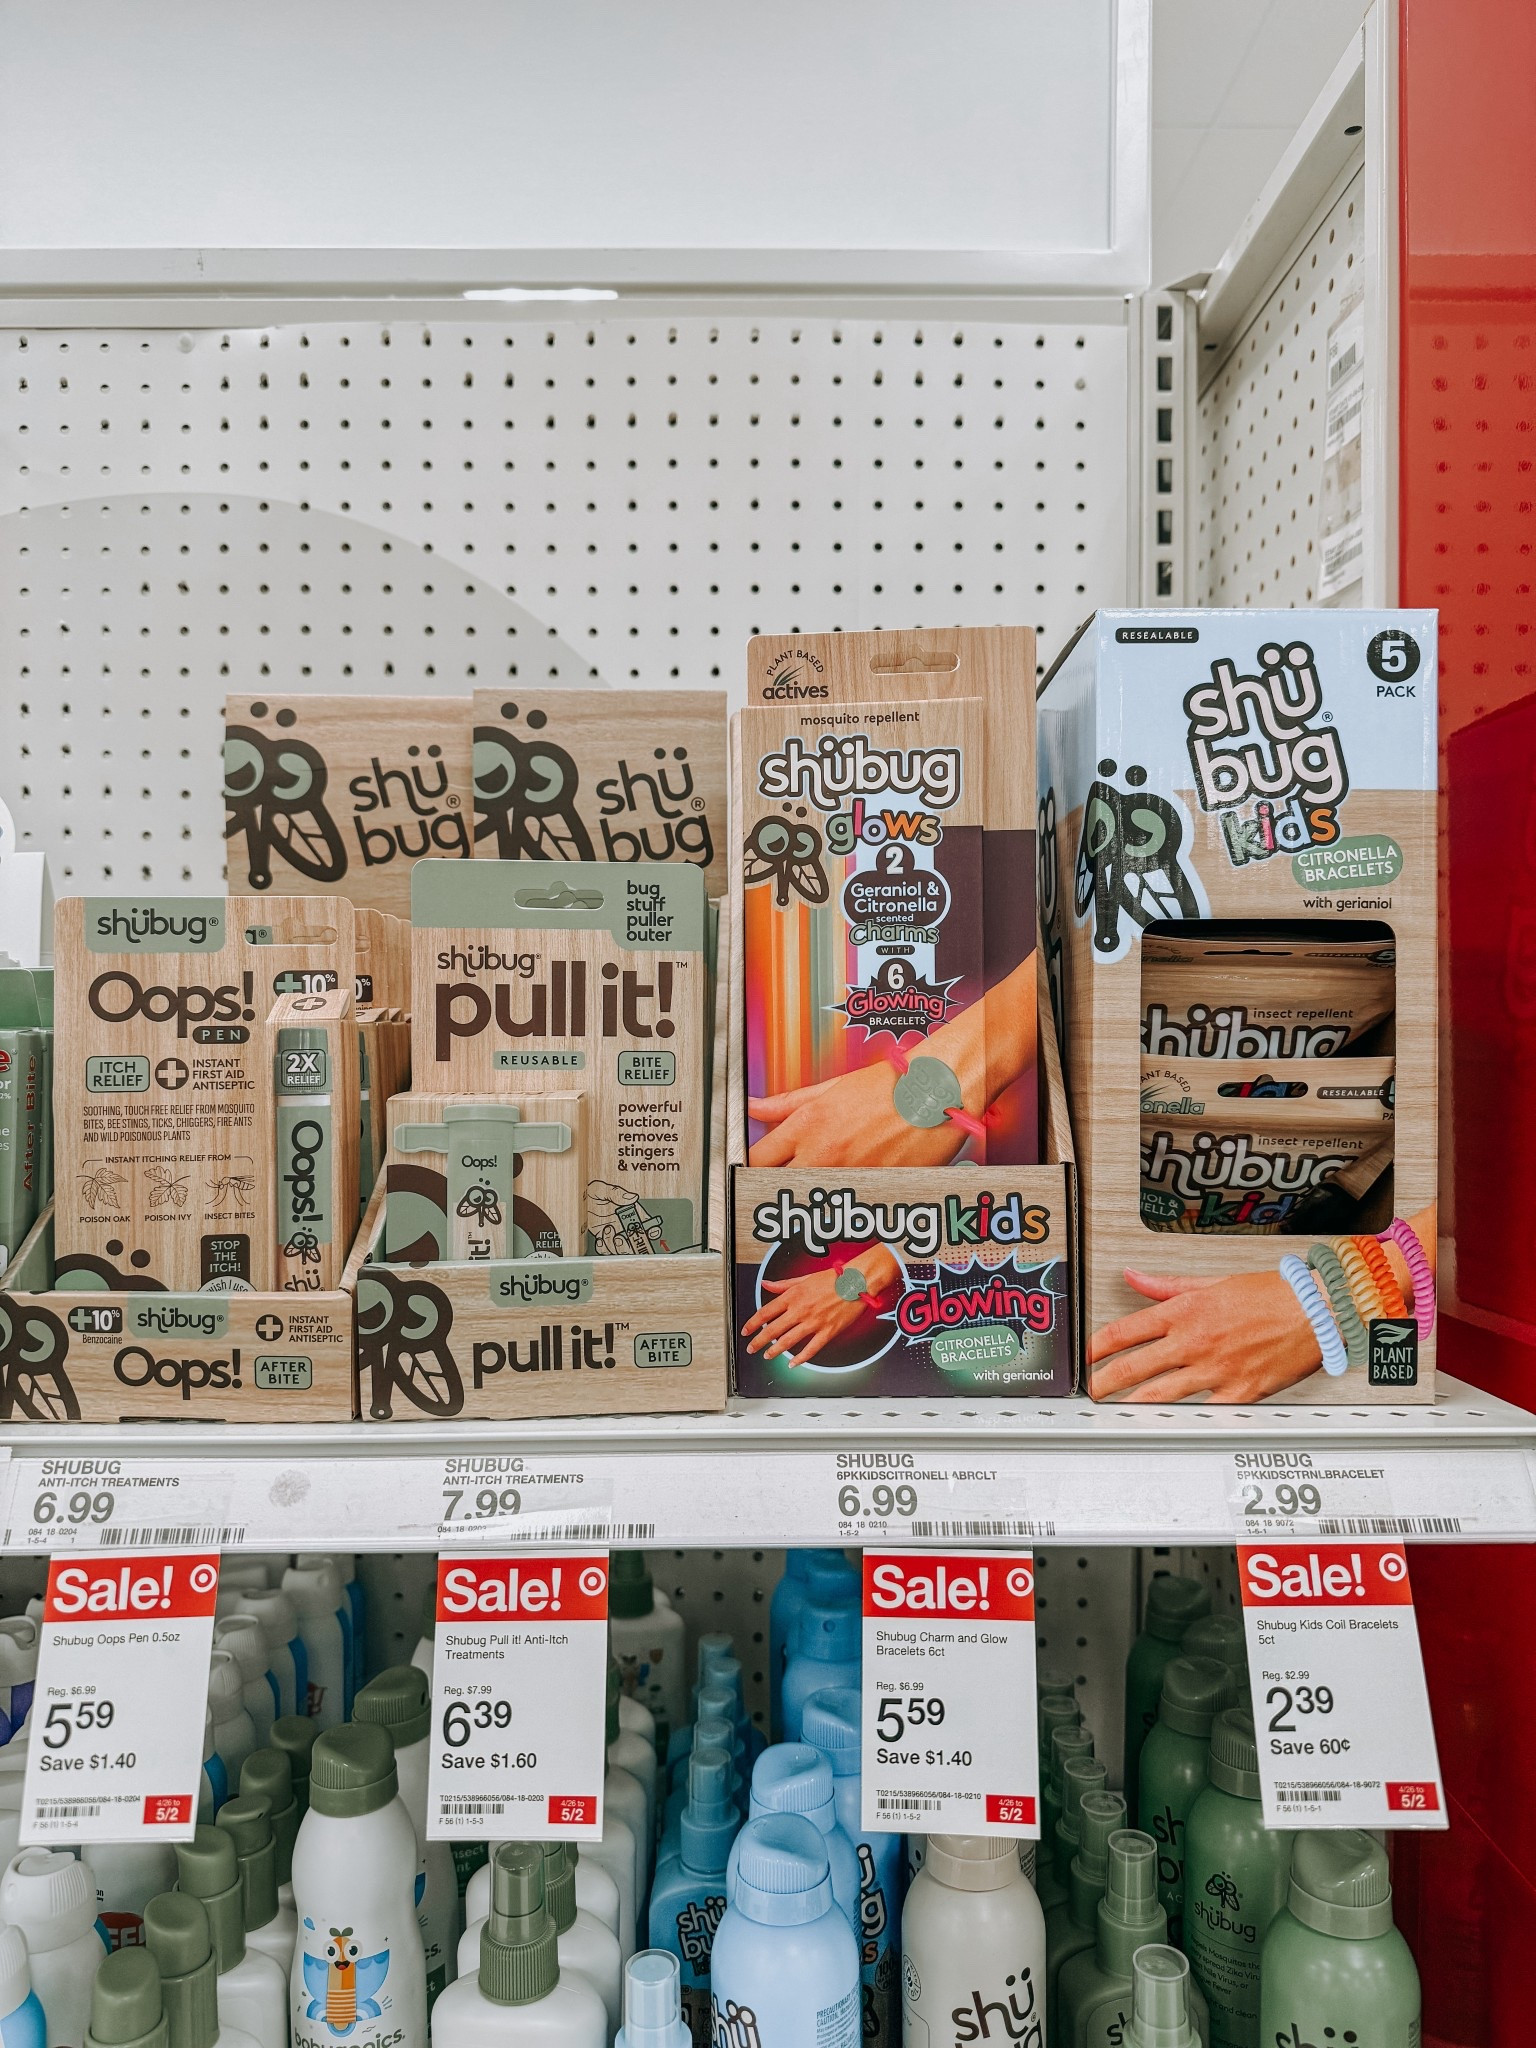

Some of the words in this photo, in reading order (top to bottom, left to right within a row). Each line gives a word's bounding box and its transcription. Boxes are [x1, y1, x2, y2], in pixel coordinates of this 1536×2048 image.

[1122, 631, 1193, 641] RESEALABLE
[1381, 640, 1407, 673] 5
[762, 681, 829, 700] actives
[1376, 685, 1416, 698] PACK
[800, 713, 860, 727] mosquito
[864, 712, 920, 724] repellent
[763, 739, 957, 808] shübug
[1192, 732, 1343, 804] bug
[828, 799, 941, 854] glows
[1221, 801, 1338, 866] kids
[353, 812, 472, 865] bug
[599, 813, 714, 868] bug
[885, 846, 904, 874] 2
[1297, 846, 1398, 868] CITRONELLA
[1304, 860, 1394, 882] BRACELETS
[627, 880, 660, 899] bug
[851, 881, 922, 897] Geraniol
[627, 897, 666, 911] stuff
[854, 898, 937, 913] Citronella
[1303, 897, 1334, 909] with
[1337, 897, 1392, 912] gerianiol
[627, 912, 674, 930] puller
[876, 914, 914, 922] scented
[627, 929, 672, 942] outer
[850, 920, 939, 945] Charms
[887, 963, 904, 989] 6
[89, 970, 256, 1038] Oops!
[848, 988, 946, 1018] Glowing
[436, 960, 586, 1062] pull
[1253, 1008, 1292, 1019] insect
[1297, 1008, 1353, 1021] repellent
[869, 1017, 926, 1026] BRACELETS
[202, 1030, 242, 1040] PEN
[99, 1062, 136, 1073] ITCH
[193, 1059, 240, 1068] INSTANT
[286, 1053, 320, 1073] 2X
[501, 1055, 578, 1066] REUSABLE
[632, 1057, 662, 1068] BITE
[93, 1074, 143, 1086] RELIEF
[193, 1069, 222, 1079] FIRST
[225, 1069, 245, 1078] AID
[287, 1075, 320, 1085] RELIEF
[624, 1069, 670, 1080] RELIEF
[25, 1054, 36, 1112] Bite
[193, 1080, 255, 1090] ANTISEPTIC
[84, 1105, 123, 1117] SOOTHING,
[124, 1105, 150, 1116] TOUCH
[151, 1105, 168, 1115] FREE
[170, 1104, 194, 1115] RELIEF
[195, 1104, 216, 1115] FROM
[217, 1103, 255, 1116] MOSQUITO
[618, 1101, 682, 1116] powerful
[618, 1116, 675, 1129] suction,
[618, 1132, 678, 1142] removes
[22, 1121, 35, 1192] After
[105, 1155, 140, 1164] INSTANT
[142, 1155, 177, 1163] ITCHING
[179, 1154, 206, 1162] RELIEF
[618, 1146, 675, 1160] stingers
[461, 1155, 498, 1171] Oops!
[631, 1163, 680, 1172] venom
[284, 1119, 324, 1223] Oops!
[144, 1214, 176, 1222] POISON
[755, 1190, 940, 1255] shübug
[948, 1194, 1049, 1243] kids
[211, 1241, 240, 1250] STOP
[214, 1252, 237, 1261] THE
[209, 1262, 241, 1273] ITCH!
[899, 1280, 1052, 1334] Glowing
[82, 1333, 123, 1345] Benzocaine
[640, 1339, 687, 1351] AFTER
[935, 1334, 1015, 1352] CITRONELLA
[473, 1325, 562, 1389] pull
[649, 1352, 680, 1363] BITE
[940, 1346, 1012, 1364] BRACELETS
[1373, 1347, 1413, 1364] PLANT
[114, 1346, 242, 1400] Oops!
[261, 1361, 307, 1373] AFTER
[1373, 1365, 1413, 1380] BASED
[269, 1374, 300, 1385] BITE
[973, 1370, 1000, 1381] with
[1002, 1370, 1054, 1383] gerianiol
[41, 1460, 121, 1475] SHUBUG
[444, 1458, 524, 1473] SHUBUG
[836, 1453, 914, 1468] SHUBUG
[1234, 1453, 1313, 1468] SHUBUG
[38, 1478, 98, 1487] ANTI-ITCH
[101, 1478, 180, 1487] TREATMENTS
[442, 1489, 522, 1521] 7.99
[838, 1484, 918, 1517] 6.99
[1242, 1484, 1322, 1515] 2.99
[33, 1492, 115, 1524] 6.99
[1247, 1552, 1366, 1598] Sale!
[53, 1565, 174, 1614] Sale!
[443, 1567, 562, 1613] Sale!
[871, 1564, 990, 1611] Sale!
[1257, 1620, 1297, 1632] Shubug
[1300, 1619, 1323, 1630] Kids
[1325, 1619, 1346, 1630] Coil
[1349, 1619, 1399, 1630] Bracelets
[53, 1635, 94, 1647] Shubug
[97, 1634, 125, 1646] Oops
[129, 1633, 149, 1643] Pen
[152, 1632, 180, 1642] 0.5oz
[446, 1635, 487, 1647] Shubug
[490, 1635, 509, 1644] Pull
[512, 1634, 521, 1644] it!
[524, 1634, 569, 1644] Anti-Itch
[876, 1631, 917, 1643] Shubug
[919, 1632, 955, 1643] Charm
[957, 1633, 977, 1643] and
[980, 1634, 1008, 1644] Glow
[1258, 1635, 1275, 1645] 5ct
[446, 1650, 505, 1659] Treatments
[876, 1646, 926, 1656] Bracelets
[928, 1647, 945, 1656] 6ct
[444, 1687, 465, 1696] Reg.
[467, 1686, 492, 1695] $7.99
[876, 1682, 897, 1692] Reg.
[899, 1681, 924, 1691] $6.99
[1270, 1739, 1314, 1755] Save
[1319, 1738, 1350, 1755] 60¢
[441, 1753, 485, 1769] Save
[490, 1752, 537, 1769] $1.60
[561, 1808, 584, 1821] 5/2
[1000, 1808, 1023, 1821] 5/2
[1195, 1901, 1256, 1943] shübug
